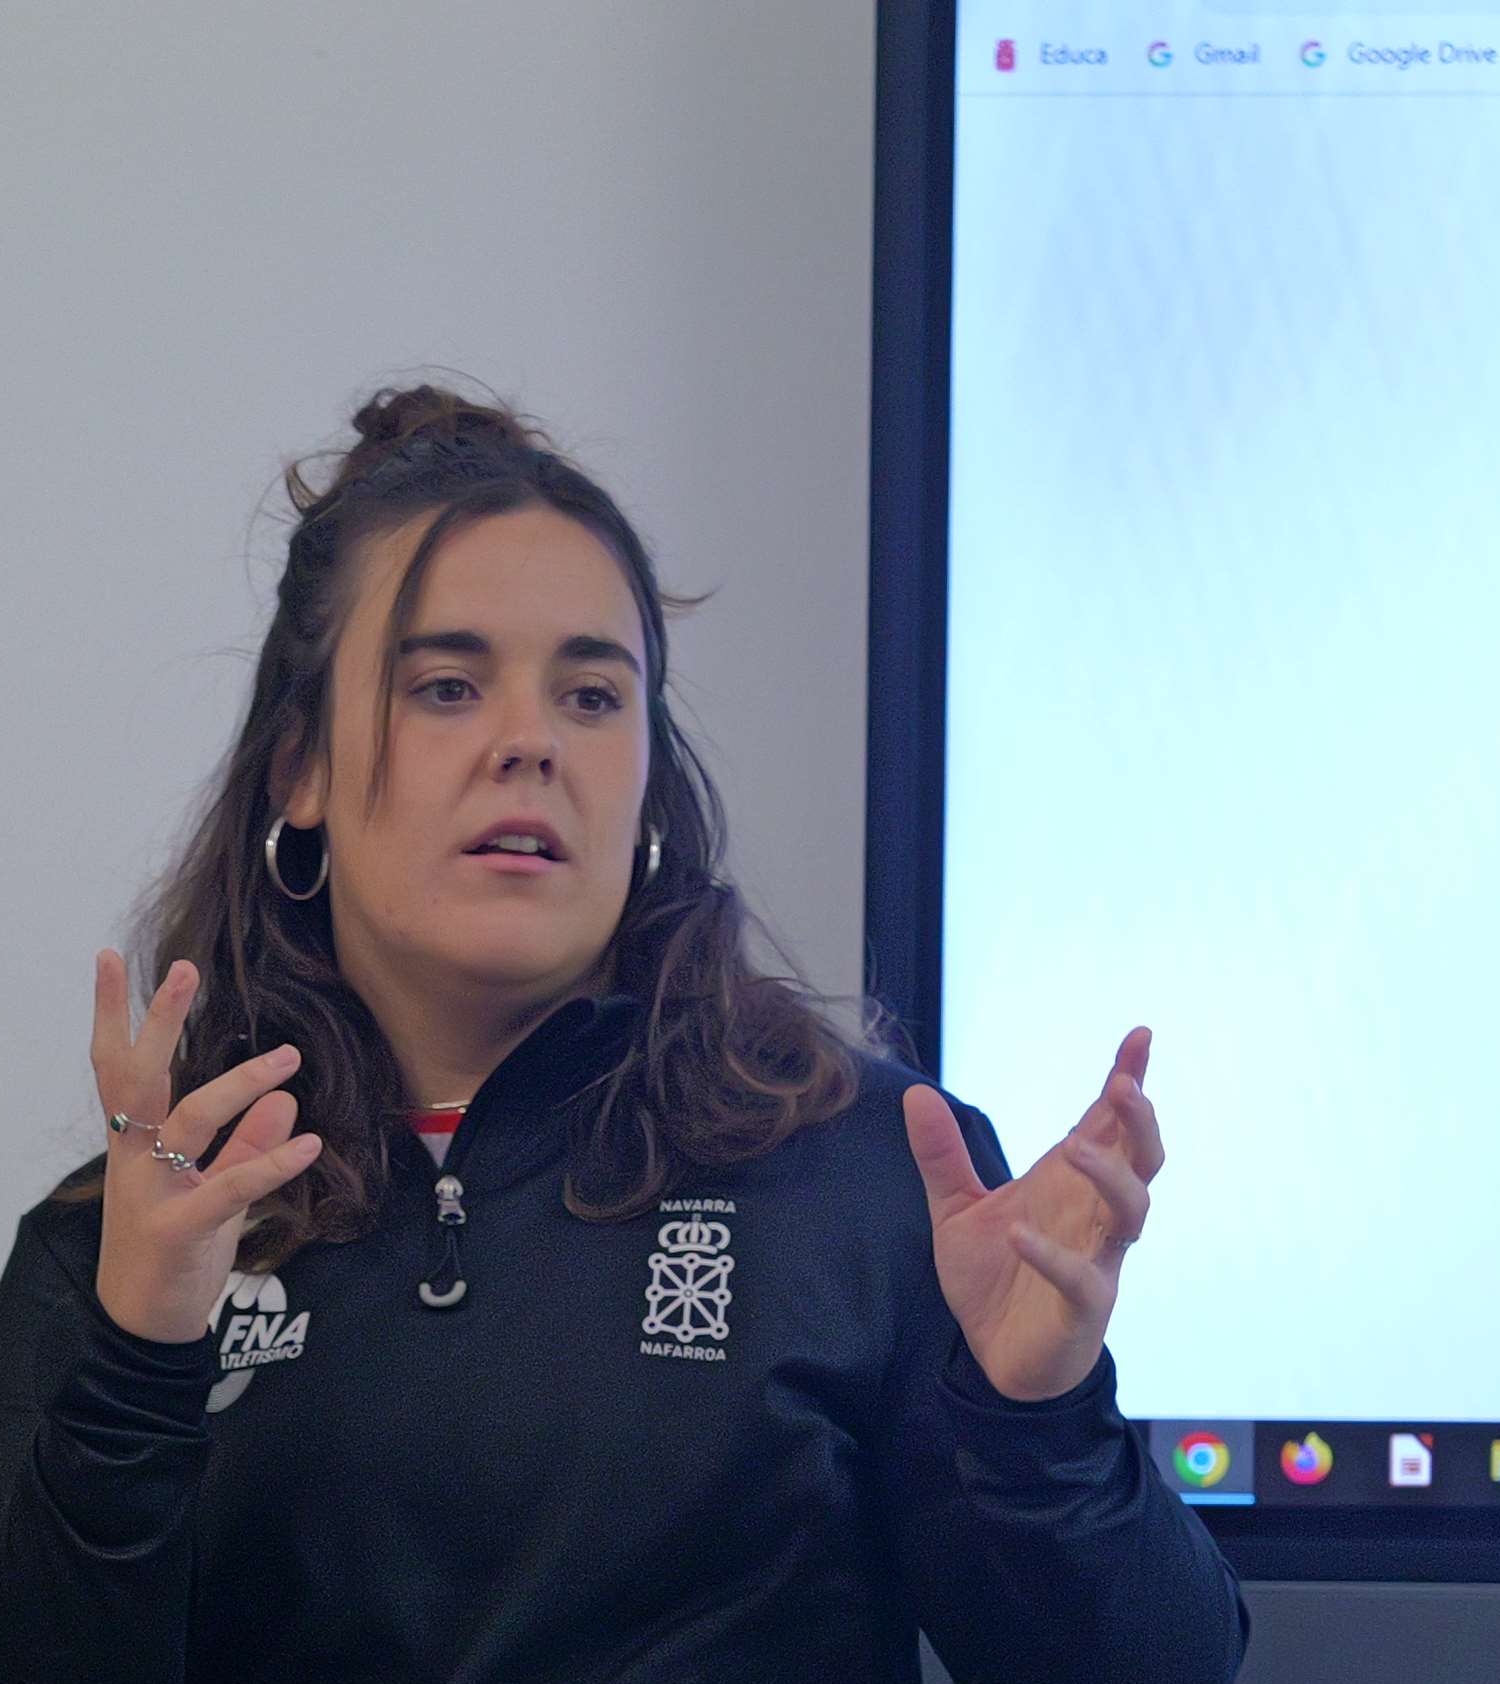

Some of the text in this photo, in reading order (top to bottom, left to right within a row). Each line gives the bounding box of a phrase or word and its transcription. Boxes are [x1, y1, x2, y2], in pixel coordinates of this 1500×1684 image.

[1040, 40, 1108, 65] Educa
[1194, 41, 1261, 65] Gmail
[1347, 41, 1498, 70] Google Drive
[659, 1198, 737, 1213] NAVARRA
[219, 1310, 311, 1354] FNA
[639, 1340, 727, 1361] NAFARROA
